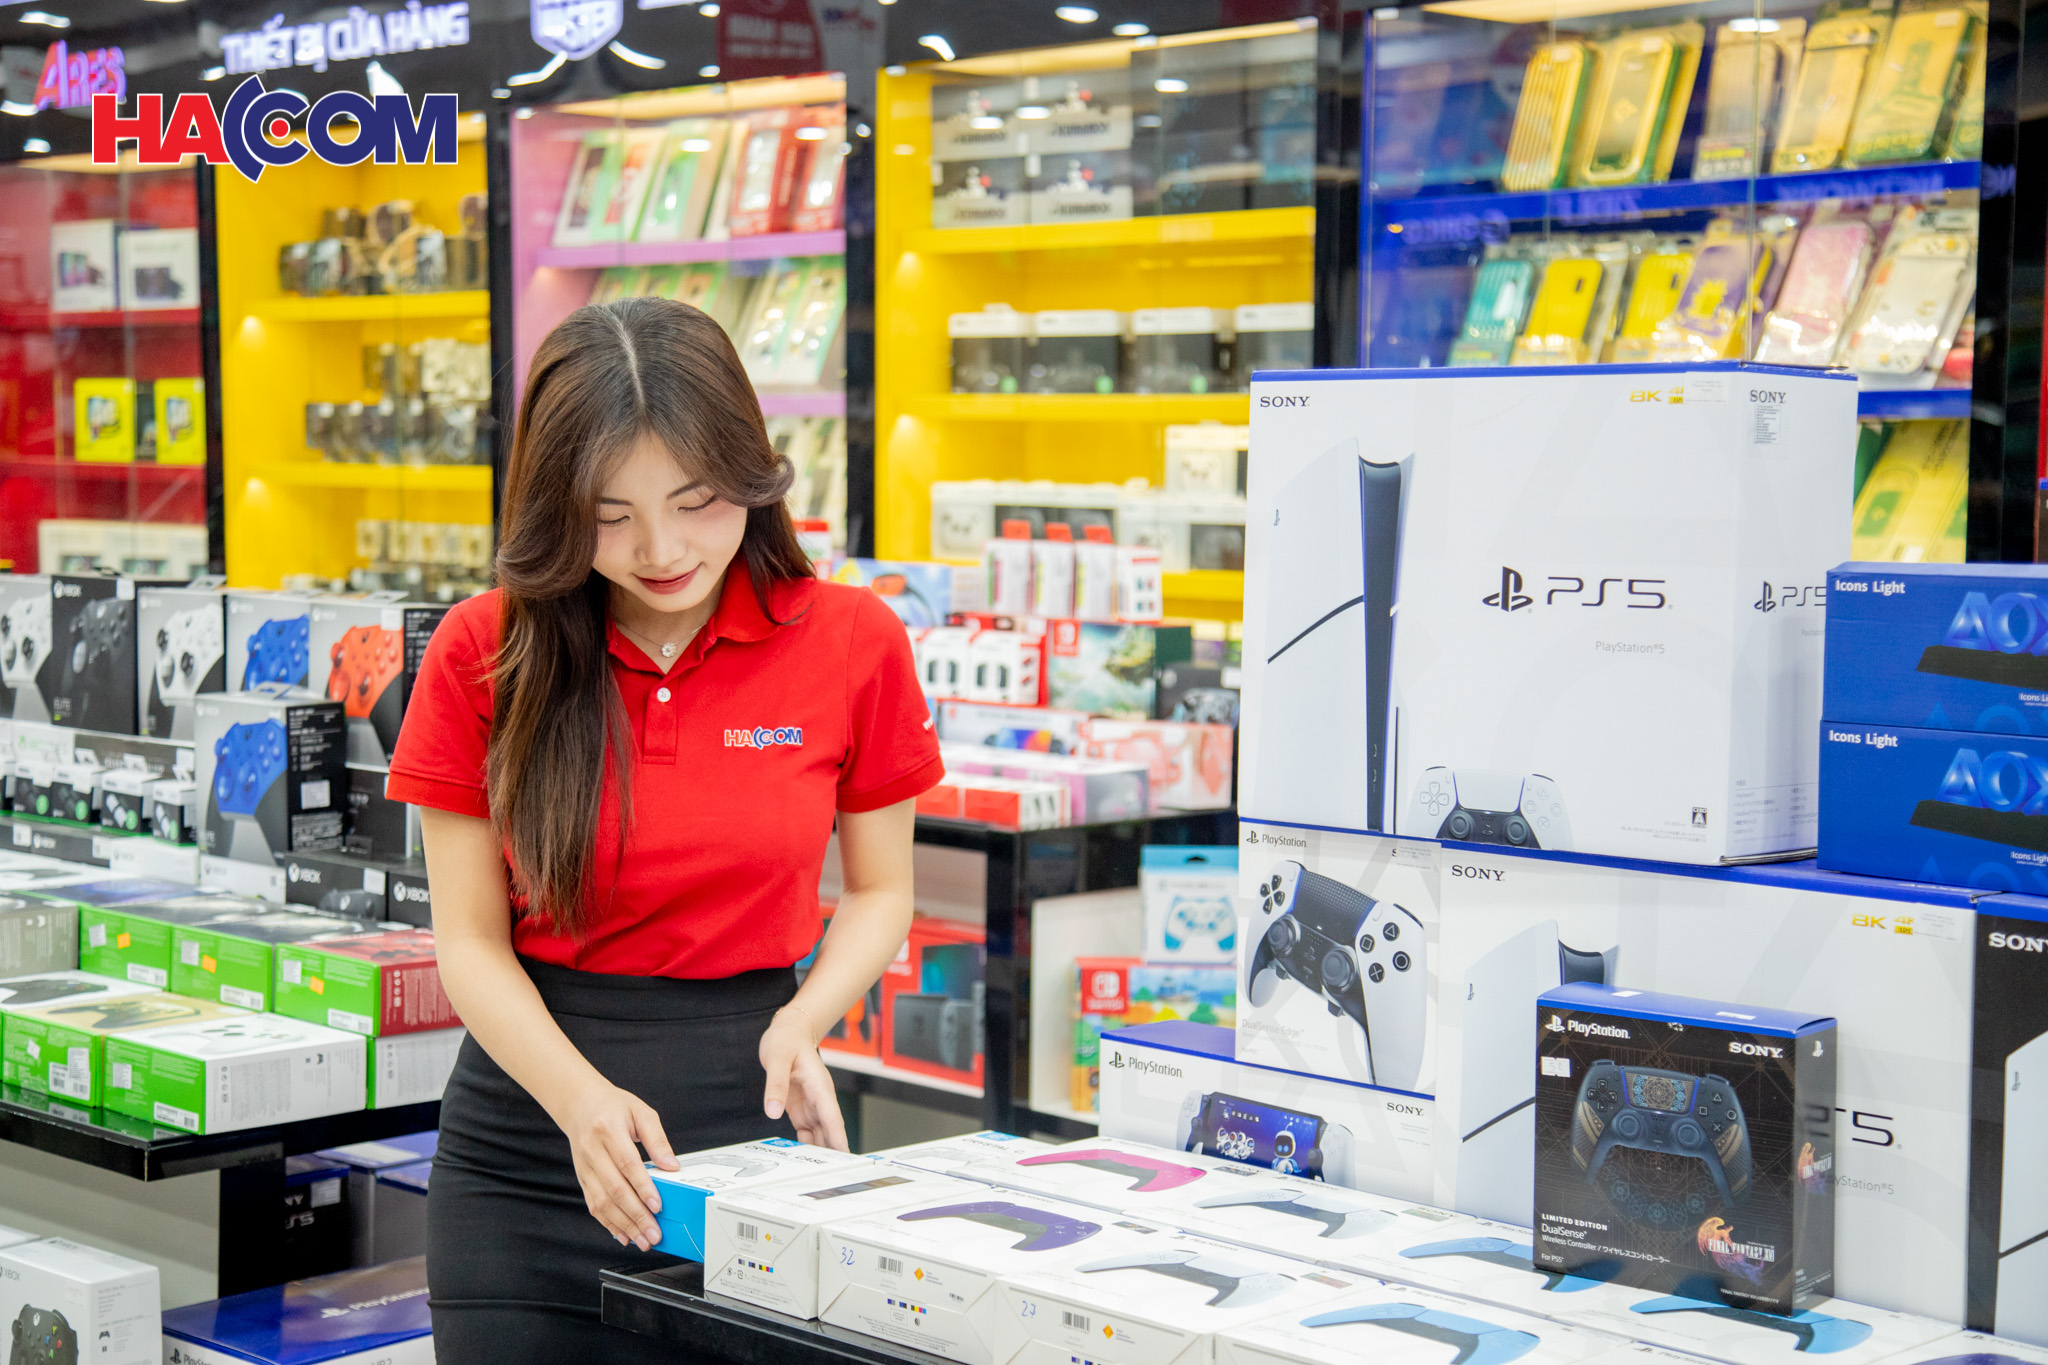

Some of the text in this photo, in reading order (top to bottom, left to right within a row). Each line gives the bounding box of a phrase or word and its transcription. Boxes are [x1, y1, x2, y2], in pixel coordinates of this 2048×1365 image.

[1259, 395, 1310, 408] SONY
[1630, 390, 1662, 402] 8K
[1749, 389, 1787, 404] SONY
[1546, 576, 1667, 609] PS5
[1834, 579, 1906, 597] Icons Light
[2018, 692, 2040, 702] Icons
[1828, 729, 1898, 749] Icons Light
[1261, 833, 1307, 848] PlayStation
[2010, 851, 2048, 863] Icons Ligh
[299, 869, 321, 884] XBOX
[1451, 864, 1506, 882] SONY
[1851, 914, 1887, 929] 8K
[1568, 1020, 1630, 1040] PlayStation
[1728, 1041, 1783, 1059] SONY
[1128, 1056, 1183, 1078] PlayStation
[1386, 1102, 1424, 1117] SONY
[1541, 1213, 1608, 1231] LIMITED EDITION
[1541, 1234, 1567, 1246] Wireless
[1567, 1239, 1597, 1251] Controller
[1708, 1238, 1733, 1255] FINAL
[1732, 1243, 1764, 1260] FANTASY
[840, 1246, 855, 1266] 32
[1541, 1253, 1551, 1261] For
